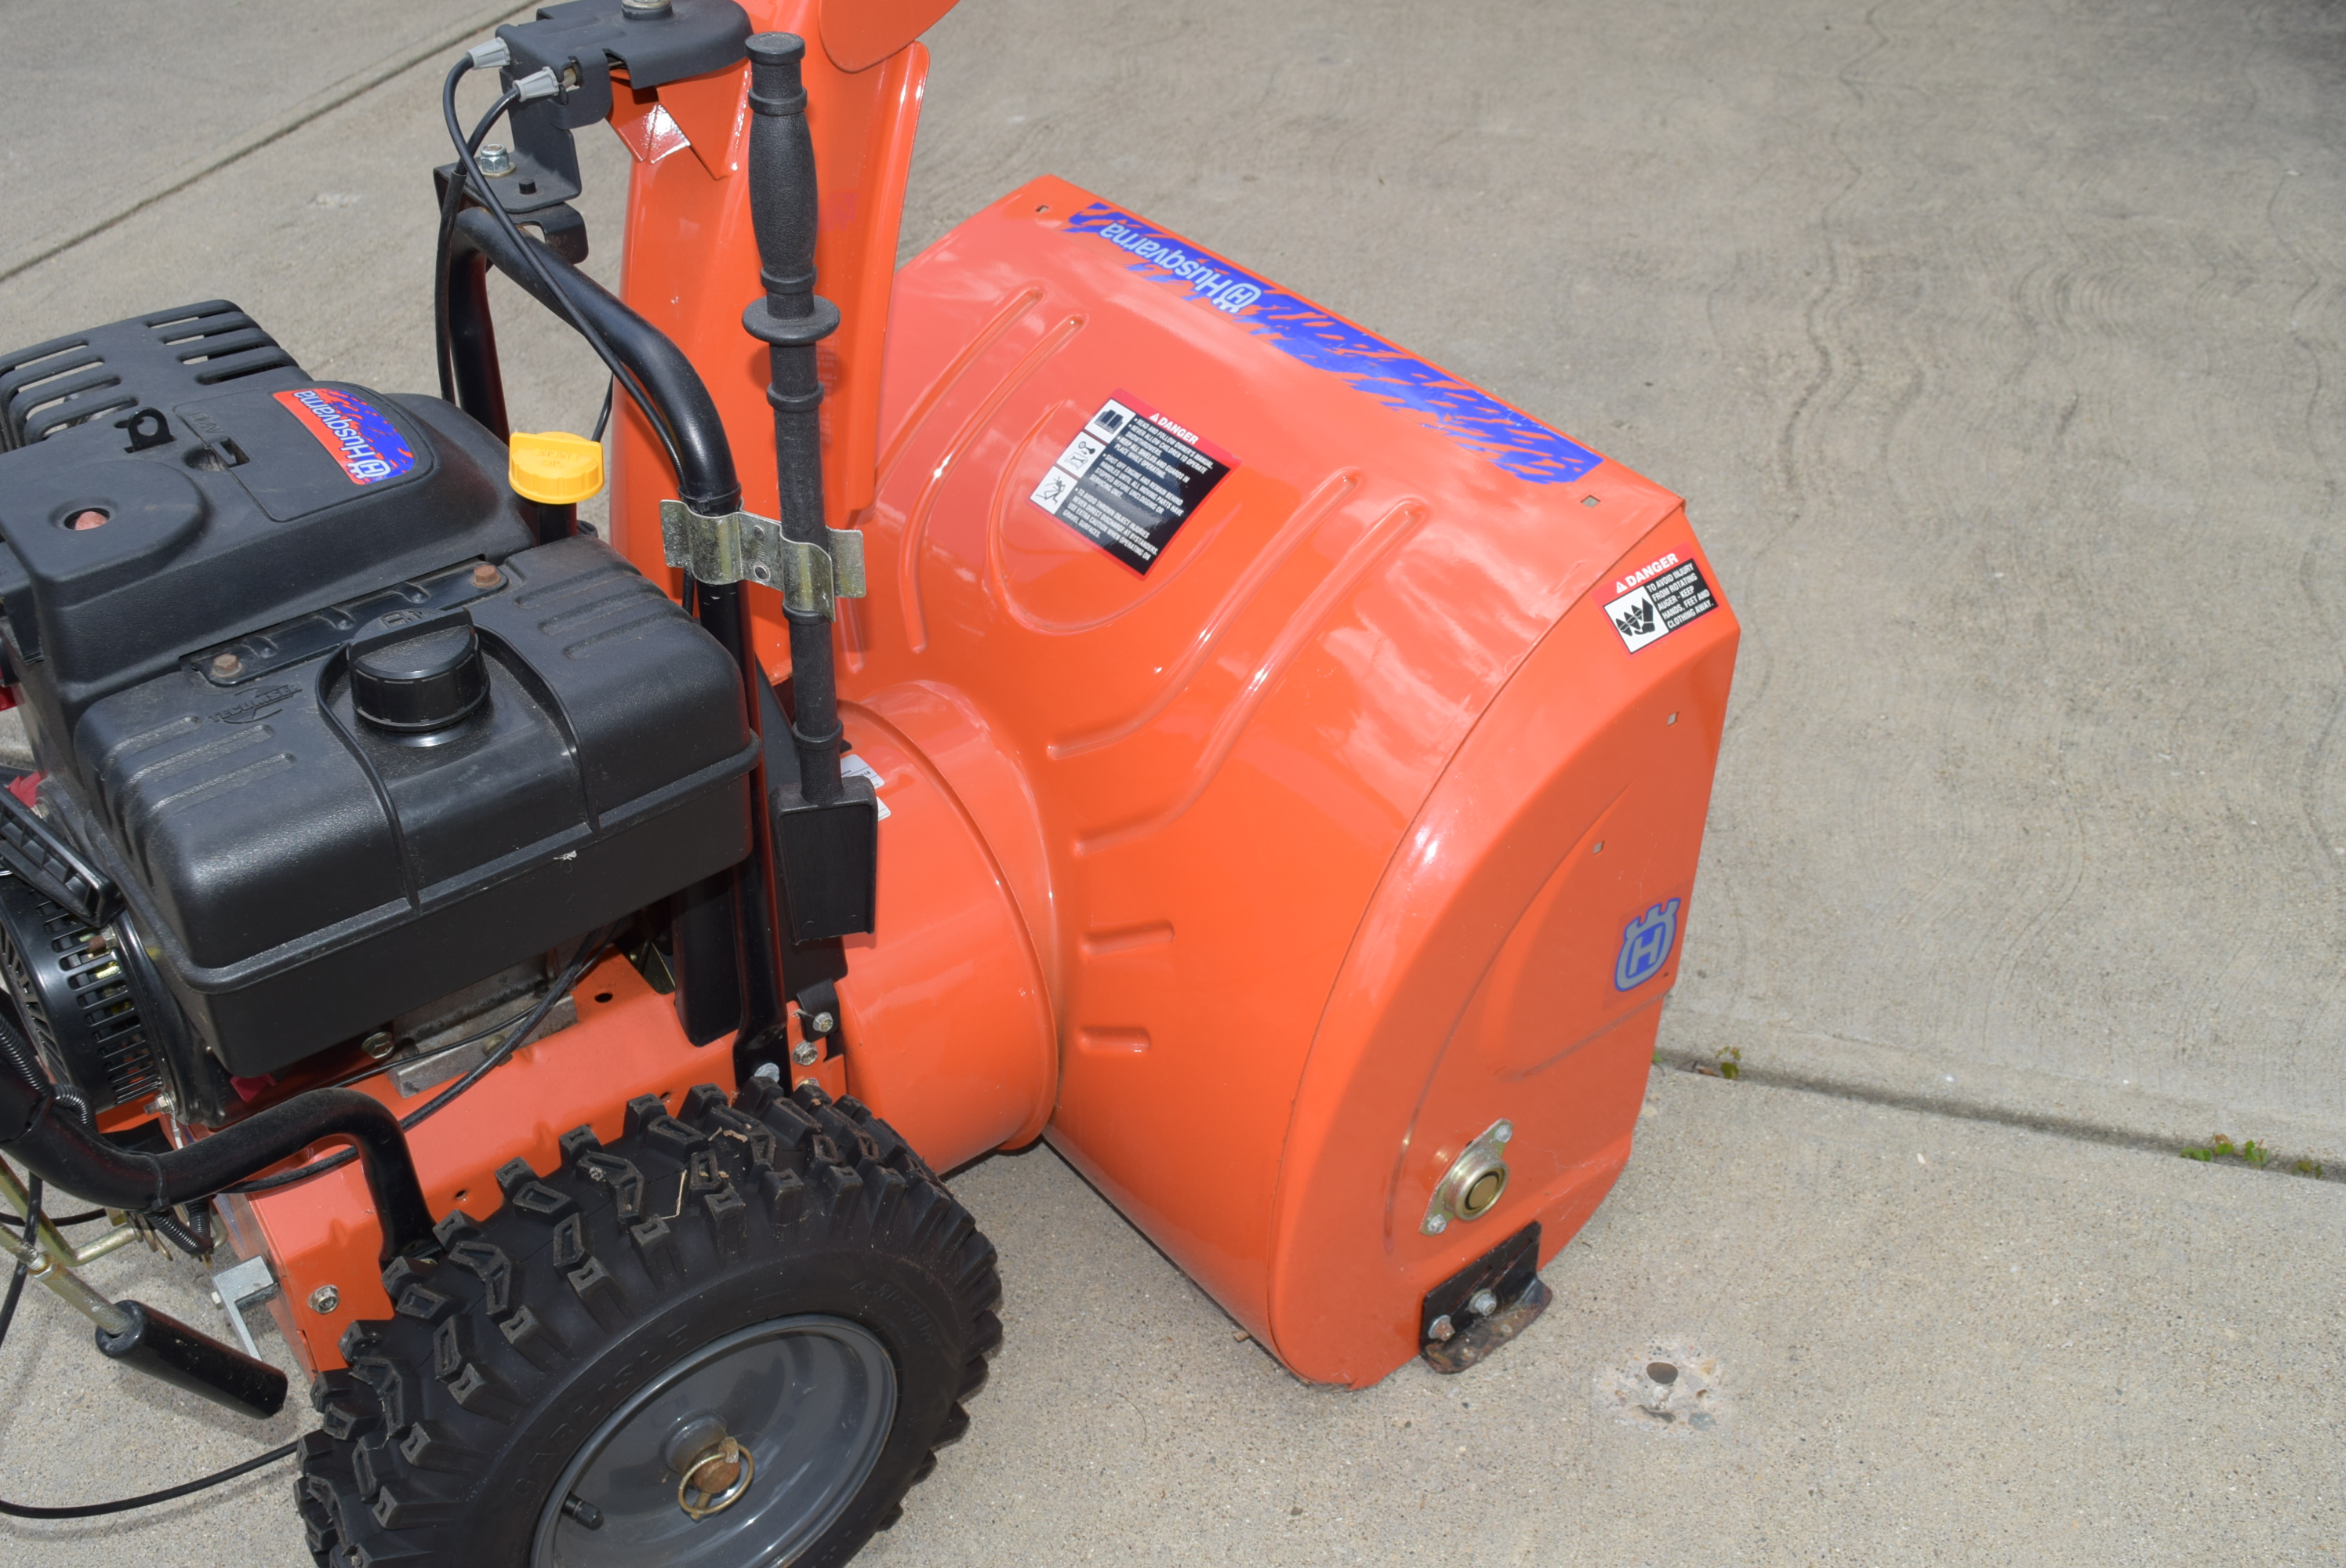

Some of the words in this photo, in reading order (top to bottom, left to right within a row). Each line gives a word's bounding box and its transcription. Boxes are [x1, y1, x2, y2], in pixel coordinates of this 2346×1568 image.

[1099, 222, 1233, 299] Husqvarna
[293, 390, 376, 459] Husqvarna
[1124, 431, 1163, 456] SNOWTHROWERS.
[1135, 419, 1149, 430] READ
[1147, 426, 1158, 434] AND
[1157, 431, 1176, 445] FOLLOW
[1174, 441, 1196, 456] OWNER'S
[1193, 453, 1215, 468] MANUAL.
[1157, 416, 1200, 445] DANGER
[1113, 443, 1128, 455] PLACE
[1127, 452, 1142, 463] WHILE
[1140, 459, 1167, 478] OPERATING.
[1119, 437, 1131, 447] KEEP
[1138, 448, 1157, 463] SHIELDS
[1155, 459, 1166, 468] AND
[1164, 465, 1184, 479] GUARDS
[1130, 425, 1146, 437] NEVER
[1143, 433, 1160, 445] ALLOW
[1158, 441, 1182, 458] CHILDREN
[1186, 458, 1208, 474] OPERATE
[1089, 474, 1112, 491] SERVICING
[1110, 488, 1124, 498] UNIT.
[1095, 467, 1114, 482] STOPPED
[1113, 479, 1131, 492] BEFORE
[1128, 489, 1157, 510] UNCLOGGING
[1099, 461, 1120, 476] HANDLES
[1118, 473, 1132, 484] UNTIL
[1130, 480, 1141, 488] ALL
[1138, 485, 1157, 499] MOVING
[1156, 496, 1171, 508] PARTS
[1170, 505, 1183, 516] HAVE
[1105, 454, 1117, 465] SHUT
[1116, 461, 1126, 470] OFF
[1124, 466, 1141, 479] ENGINE
[1139, 476, 1150, 485] AND
[1149, 481, 1167, 495] REMAIN
[1165, 492, 1183, 506] BEHIND
[1062, 509, 1080, 523] GRAVEL
[1077, 519, 1102, 538] SURFACES.
[1067, 502, 1077, 511] USE
[1075, 508, 1091, 520] EXTRA
[1088, 517, 1108, 532] CAUTION
[1106, 528, 1120, 540] WHEN
[1118, 536, 1144, 556] OPERATING
[1142, 552, 1151, 561] ON
[1072, 495, 1088, 508] NEVER
[1085, 504, 1102, 517] DIRECT
[1099, 514, 1124, 532] DISCHARGE
[1128, 532, 1159, 555] BYSTANDERS.
[1083, 492, 1098, 504] AVOID
[1095, 501, 1115, 516] THROWN
[1113, 512, 1131, 525] OBJECT
[1128, 522, 1149, 538] INJURIES
[1625, 553, 1680, 587] DANGER
[1647, 583, 1656, 593] TO
[1655, 573, 1674, 588] AVOID
[1672, 563, 1694, 579] INJURY
[1651, 587, 1670, 601] FROM
[1669, 572, 1698, 592] ROTATING
[1657, 594, 1677, 611] AUGER
[1680, 585, 1695, 598] KEEP
[1661, 602, 1685, 620] HANDS,
[1683, 595, 1698, 608] FEET
[1697, 589, 1709, 601] AND
[1667, 608, 1695, 629] CLOTHING
[1694, 598, 1713, 613] AWAY.
